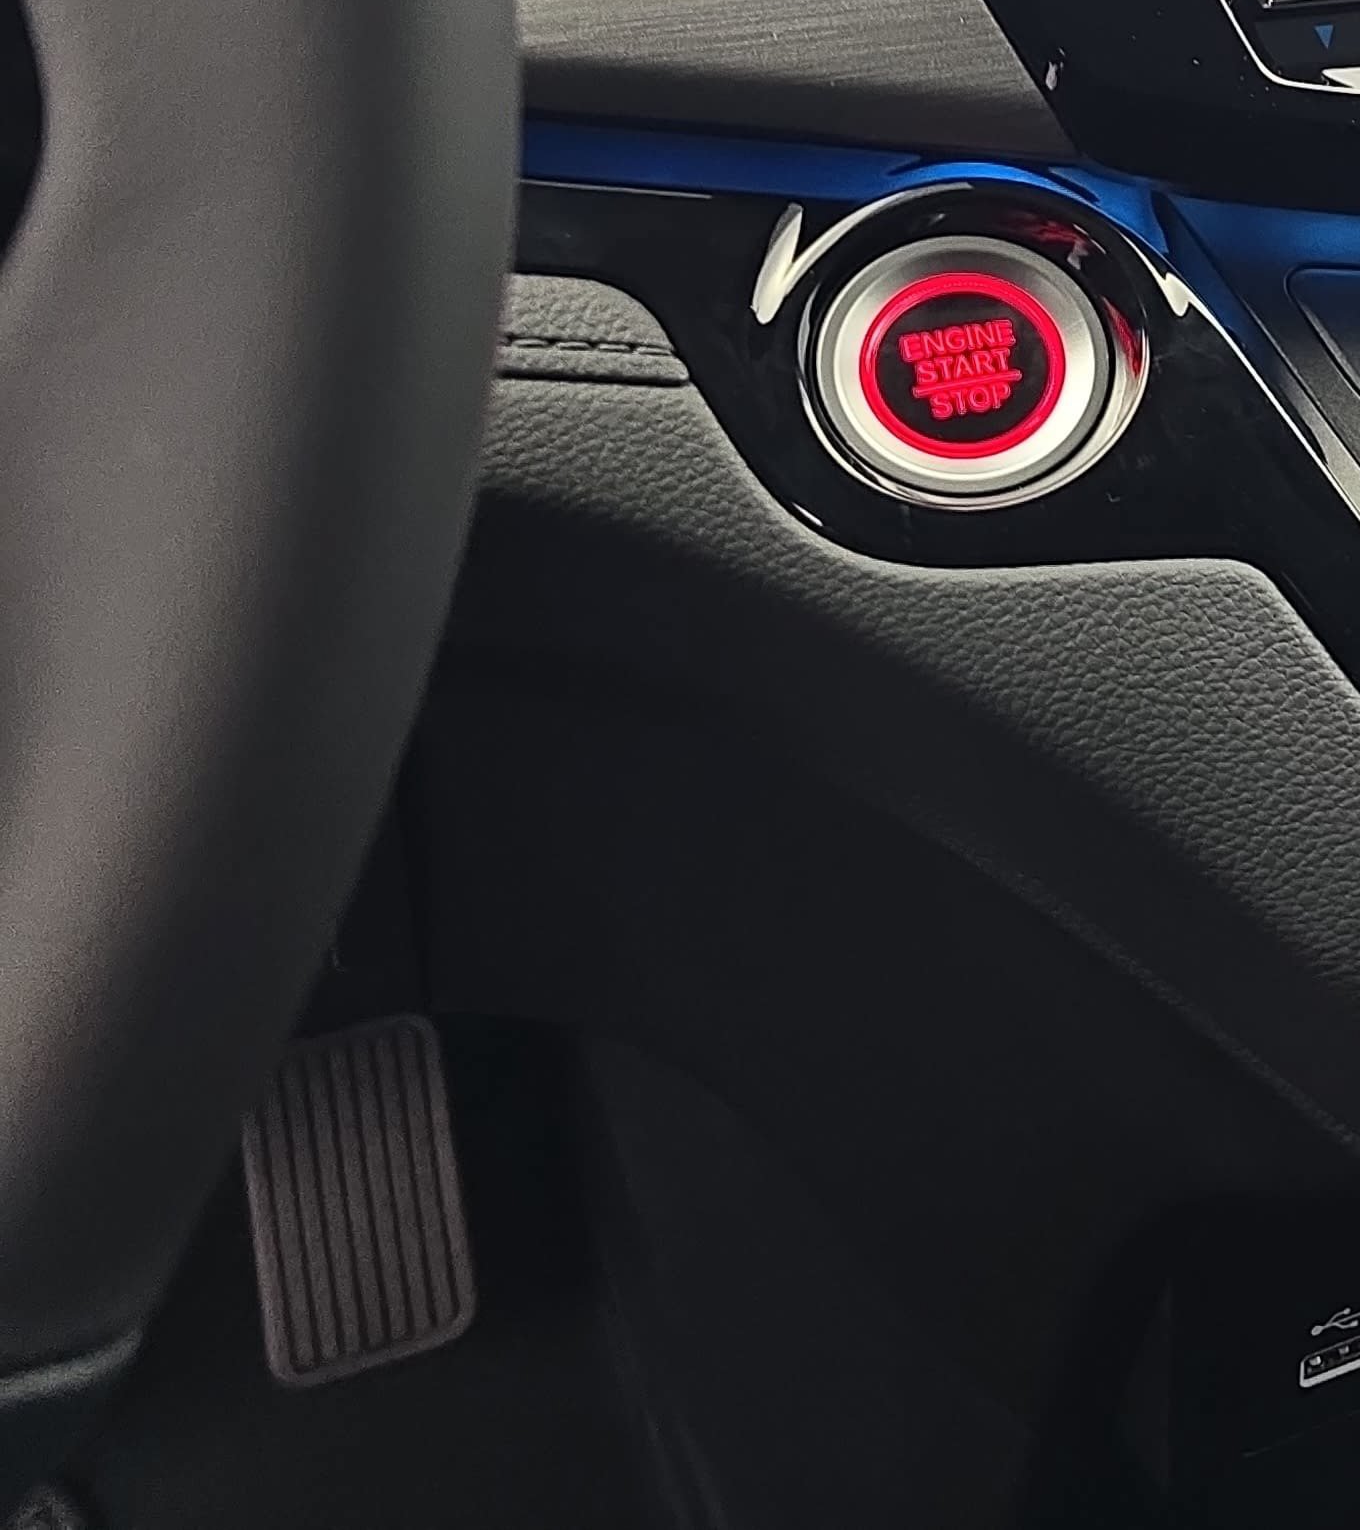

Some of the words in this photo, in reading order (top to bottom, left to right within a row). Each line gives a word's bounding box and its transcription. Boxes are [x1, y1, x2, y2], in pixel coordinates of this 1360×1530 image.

[901, 320, 1016, 361] ENGINE
[916, 348, 1011, 384] START
[931, 382, 1011, 420] STOP
